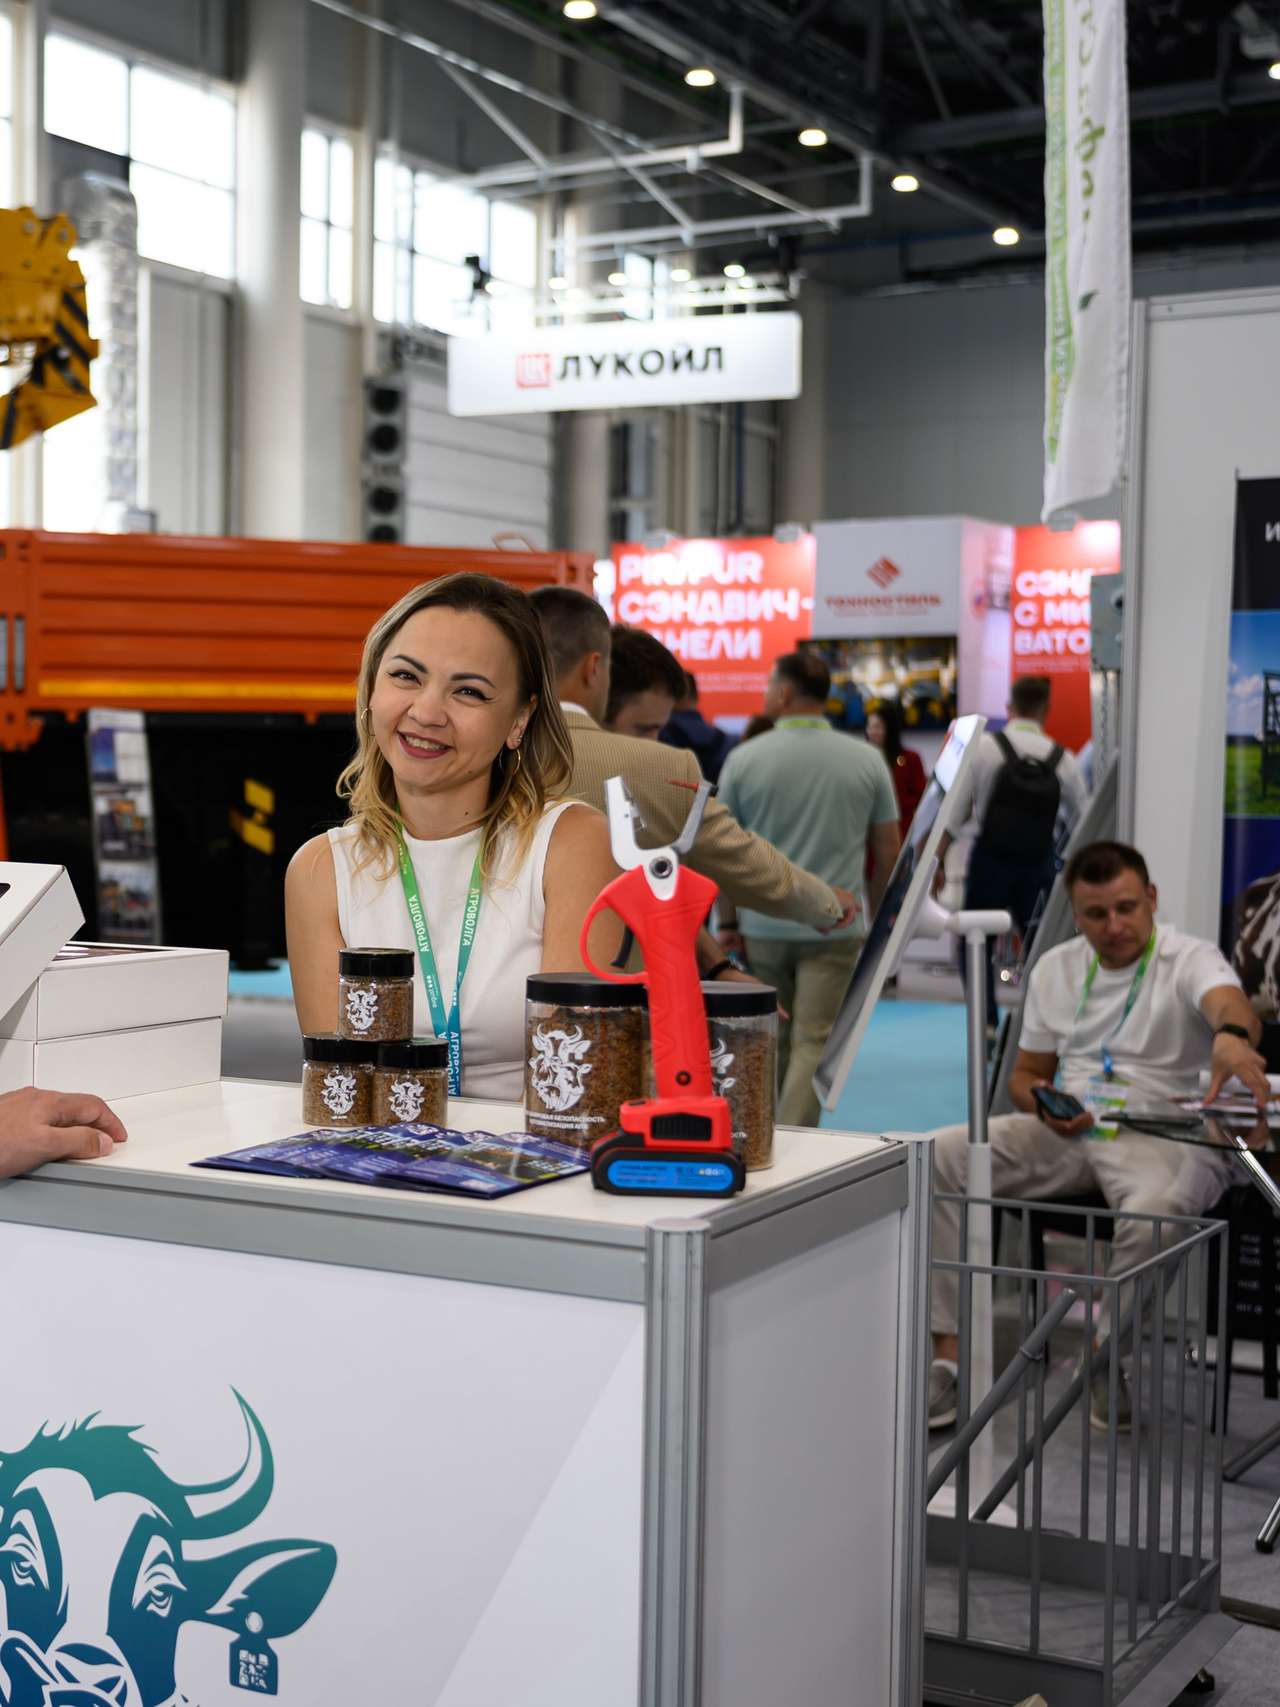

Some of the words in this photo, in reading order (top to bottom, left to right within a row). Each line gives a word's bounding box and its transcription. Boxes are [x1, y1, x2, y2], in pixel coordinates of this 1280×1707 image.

[558, 342, 723, 381] ЛУКОЙЛ
[619, 551, 763, 586] PIR/PUR
[1014, 600, 1038, 627] С
[651, 628, 762, 660] НЕЛИ
[1014, 628, 1092, 655] ВАТО
[408, 894, 430, 953] АГРОВОЛГА
[462, 887, 480, 947] АГРОВОЛГА
[426, 987, 437, 1009] avgust
[554, 1114, 605, 1123] БЕЗОПАСНОСТЬ
